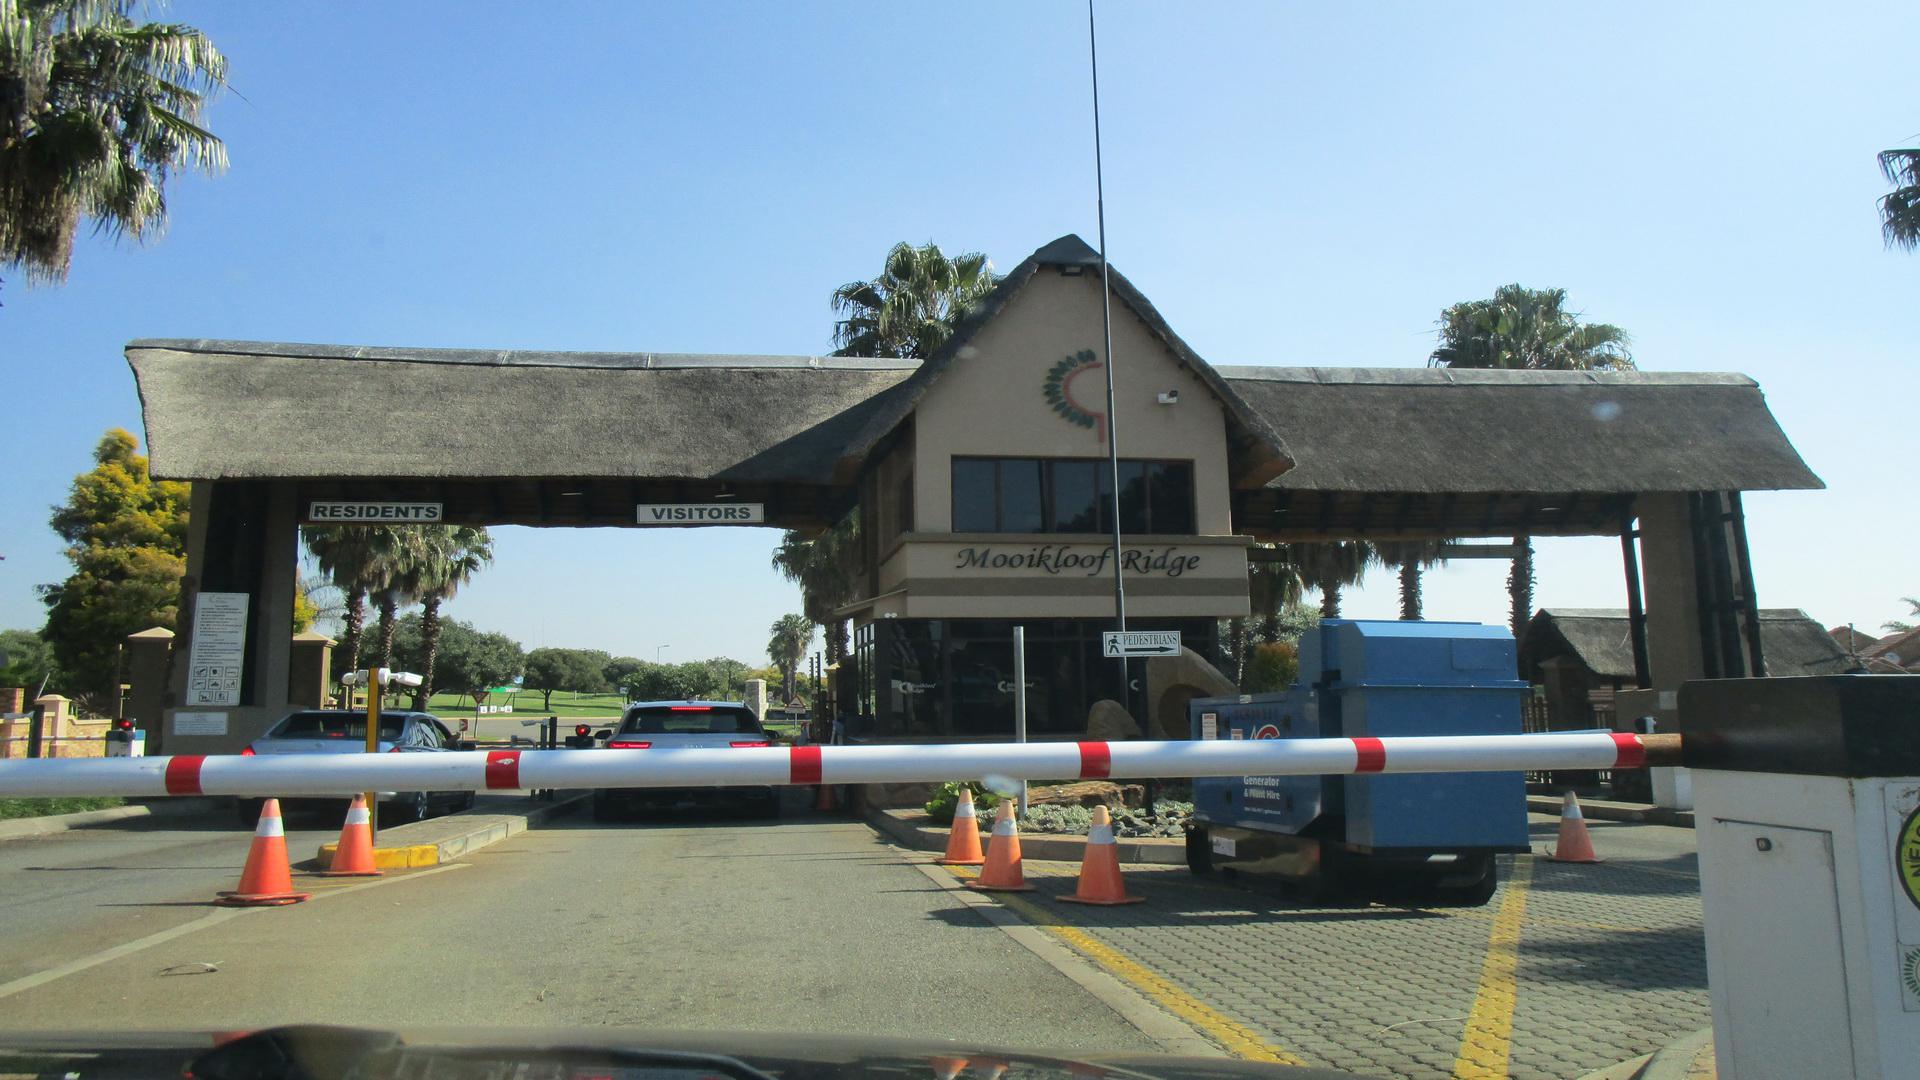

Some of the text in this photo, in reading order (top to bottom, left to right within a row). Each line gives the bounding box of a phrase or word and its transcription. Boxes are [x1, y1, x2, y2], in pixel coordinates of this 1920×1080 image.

[313, 505, 438, 519] RESIDENTS
[651, 507, 751, 520] VISITORS
[956, 545, 1201, 577] Mooikloof Ridge
[1123, 633, 1177, 646] PEDESTRIANS
[1243, 776, 1280, 787] Generator
[1266, 790, 1280, 800] Hire
